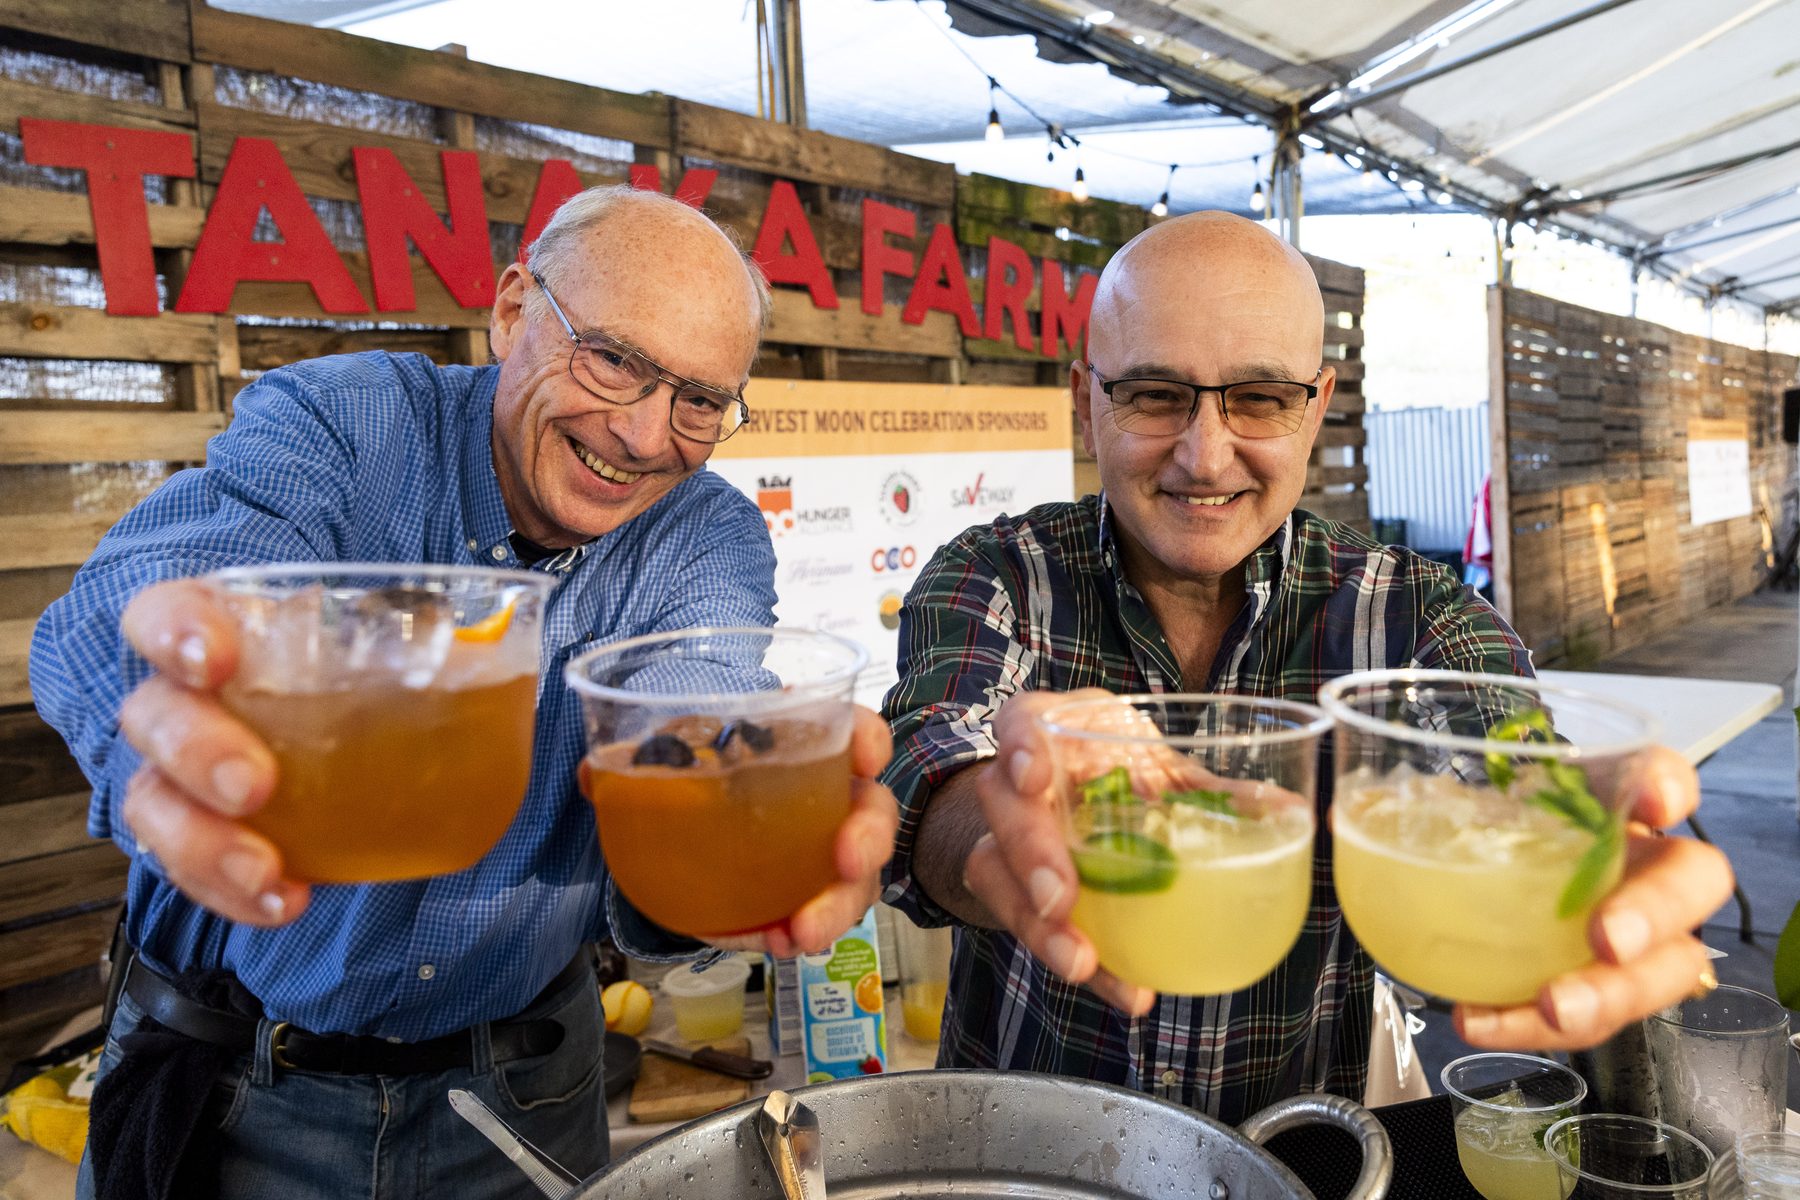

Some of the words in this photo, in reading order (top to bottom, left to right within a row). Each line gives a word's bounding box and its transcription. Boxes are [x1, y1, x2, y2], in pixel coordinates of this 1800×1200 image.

[19, 116, 840, 318] TANA
[861, 197, 1100, 365] FARM
[741, 409, 807, 433] RVEST
[814, 409, 865, 433] MOON
[869, 410, 974, 433] CELEBRATION
[976, 410, 1048, 432] SPONSORS
[797, 506, 851, 523] HUNGER
